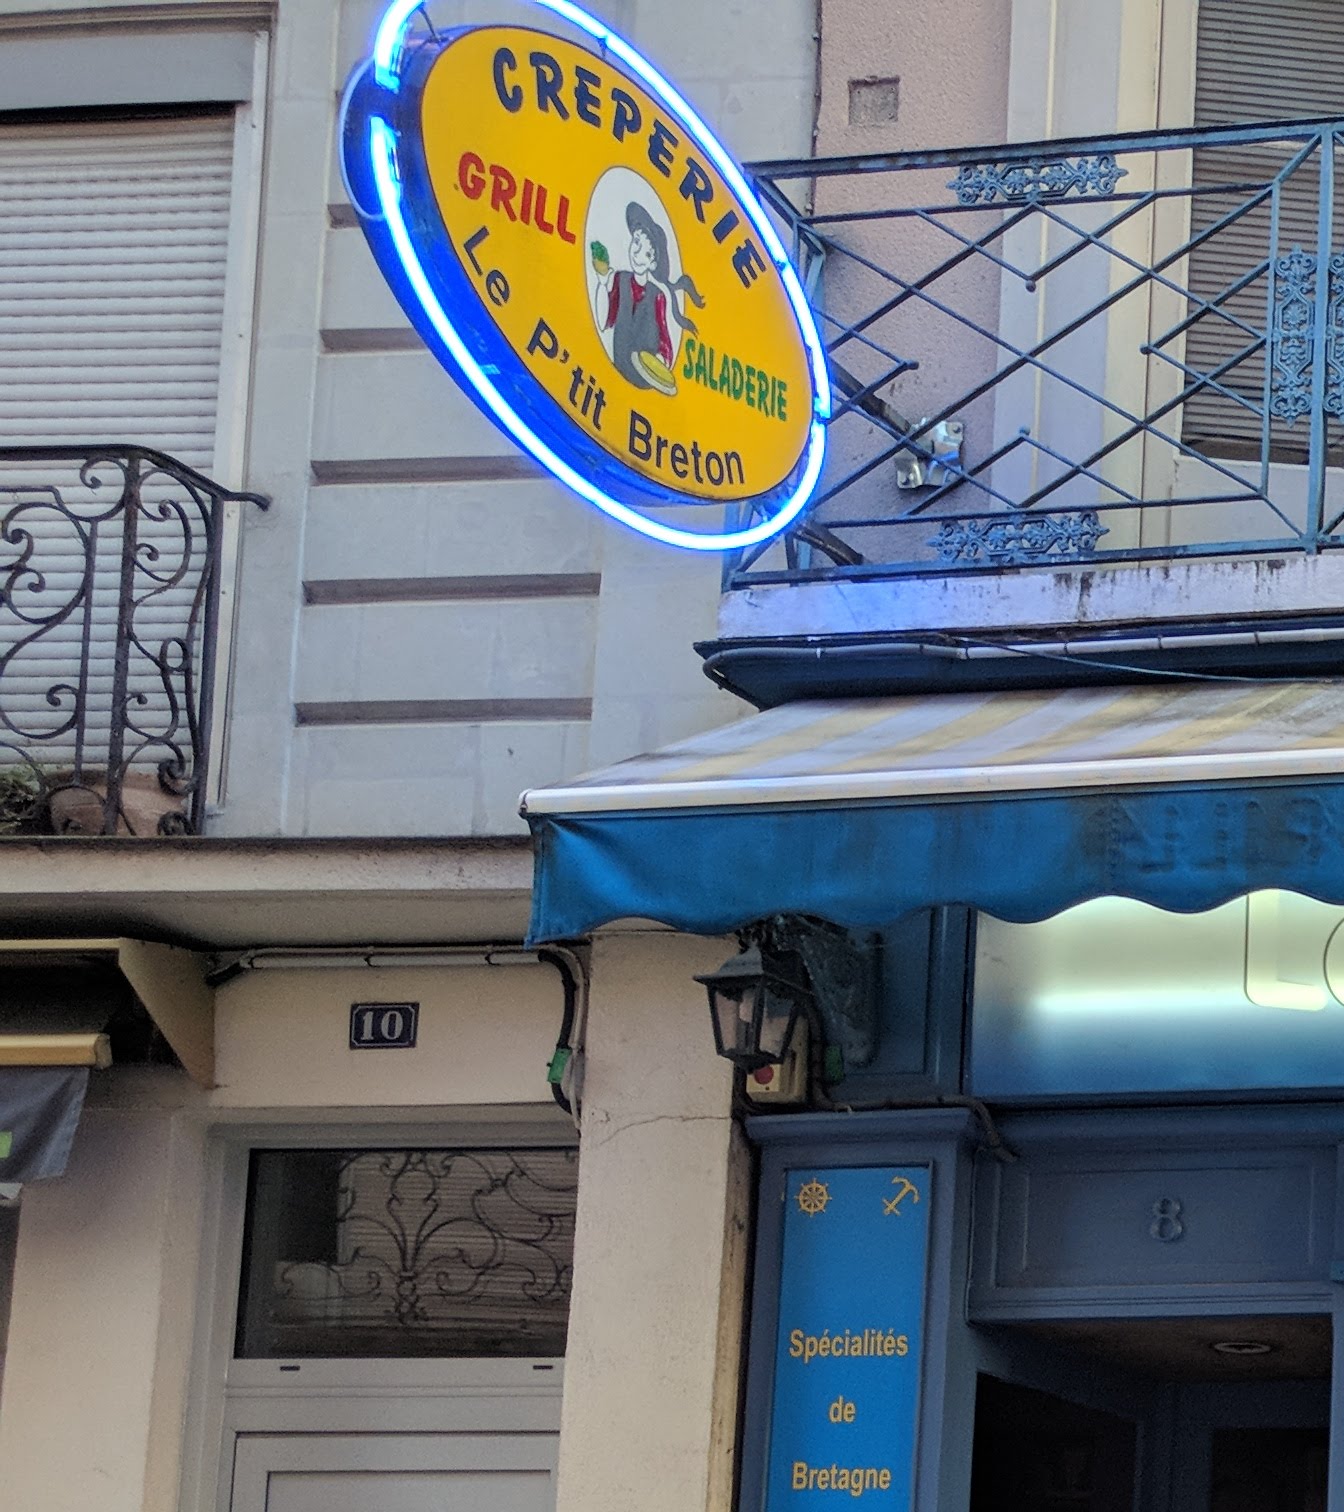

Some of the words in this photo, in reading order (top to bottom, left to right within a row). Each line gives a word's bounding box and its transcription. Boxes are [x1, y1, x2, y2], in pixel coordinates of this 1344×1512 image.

[492, 46, 768, 289] CREPERIE
[458, 151, 576, 244] GRILL
[462, 224, 511, 306] Le
[527, 318, 607, 431] P'tit
[628, 410, 744, 486] Breton
[682, 337, 788, 421] SALADERIE
[360, 1010, 404, 1041] 10
[1150, 1198, 1184, 1242] 8
[789, 1328, 909, 1363] Spécialités
[828, 1396, 856, 1423] de
[792, 1462, 892, 1497] Bretagne
